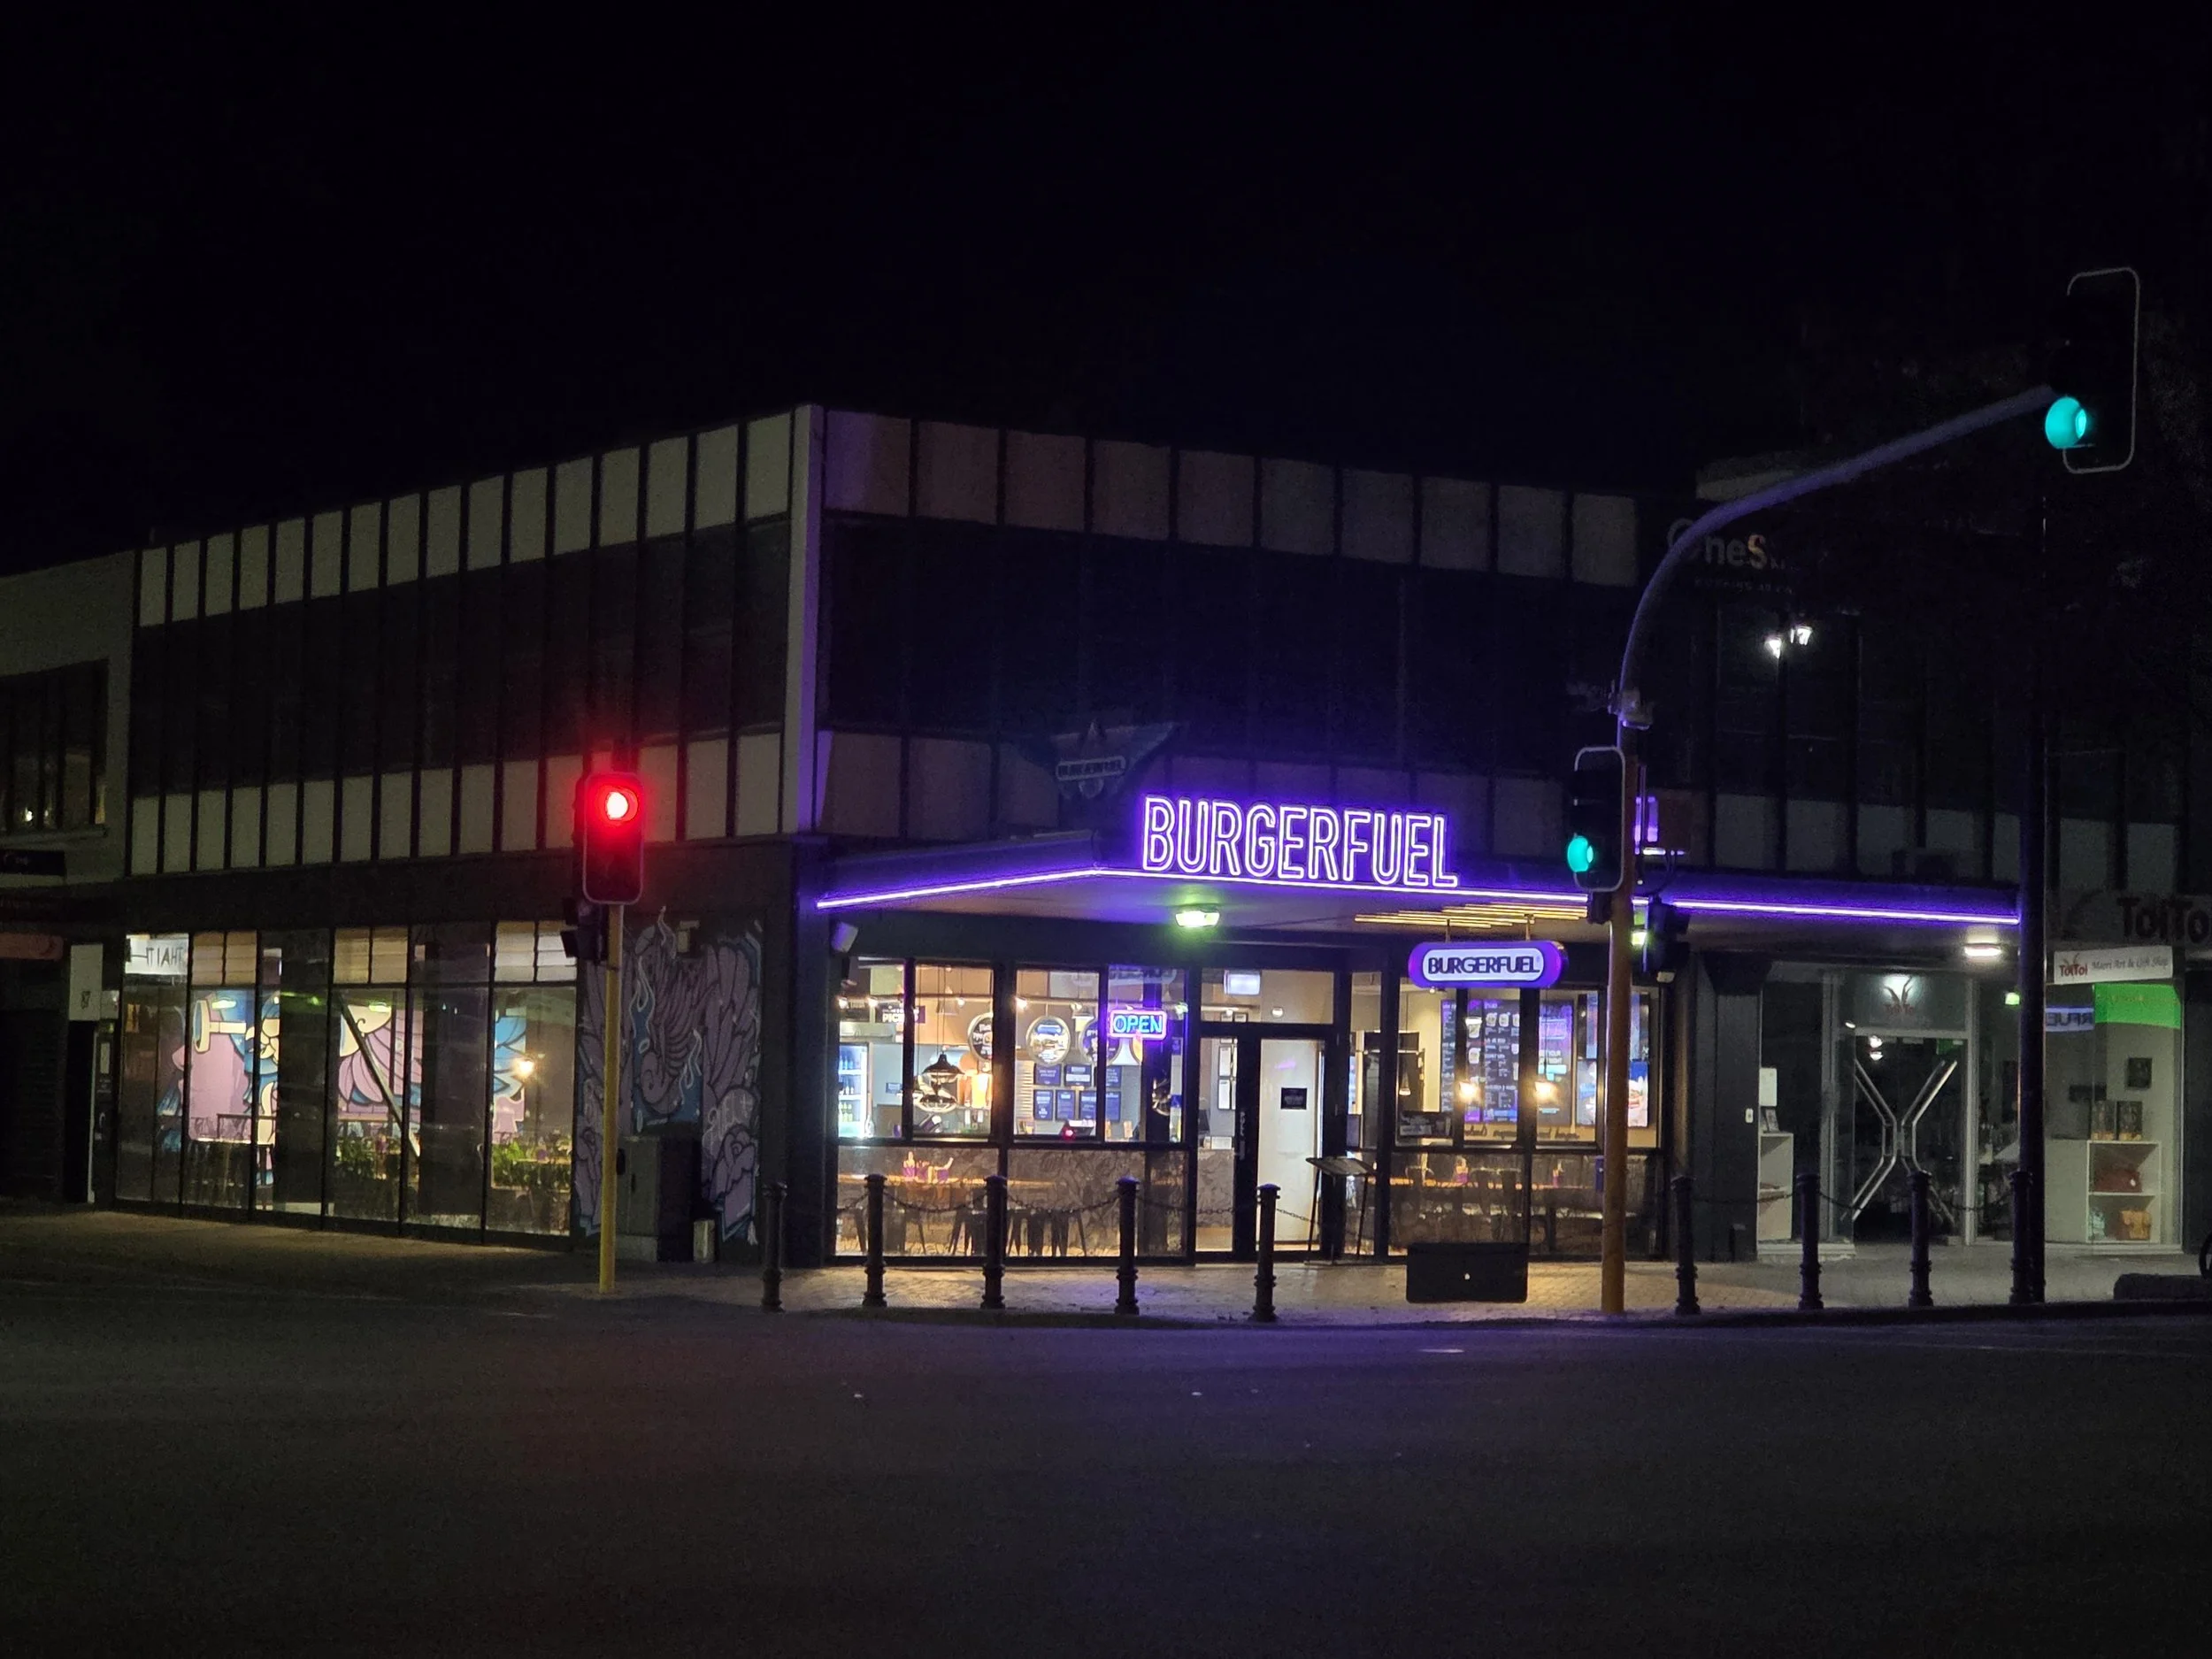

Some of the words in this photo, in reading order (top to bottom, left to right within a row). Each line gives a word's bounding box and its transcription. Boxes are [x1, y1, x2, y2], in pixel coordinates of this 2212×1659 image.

[1141, 794, 1460, 889] BURGERFUEL
[1427, 956, 1540, 975] BURGERFUEL
[1114, 1015, 1163, 1033] OPEN
